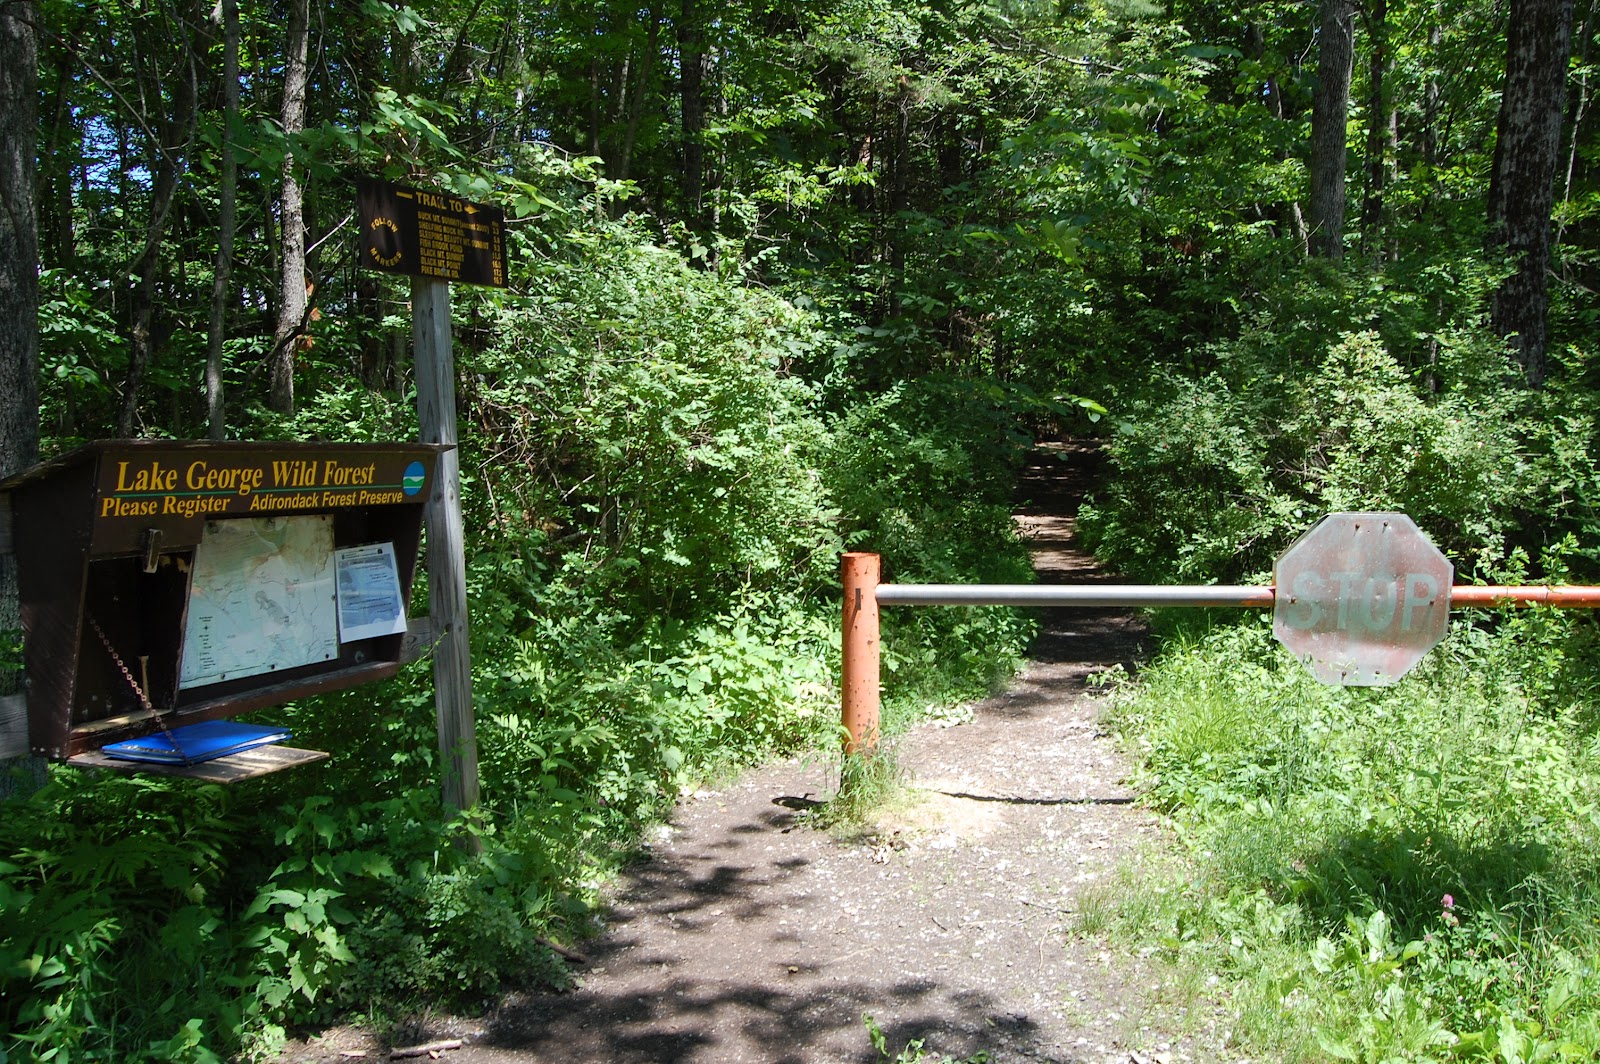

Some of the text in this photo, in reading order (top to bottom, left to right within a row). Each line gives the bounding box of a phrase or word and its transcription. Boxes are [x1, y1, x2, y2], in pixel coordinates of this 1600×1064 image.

[416, 192, 463, 212] TRAIL TO
[371, 216, 398, 233] FOLLOW
[370, 247, 402, 267] MARKERS
[420, 247, 436, 257] BLACK
[420, 256, 437, 266] BLACK
[115, 461, 376, 496] Lake George Wild Forest
[100, 495, 230, 519] Please Register
[250, 488, 403, 511] Adirondack Forest Preserve
[1286, 570, 1439, 632] STOP
